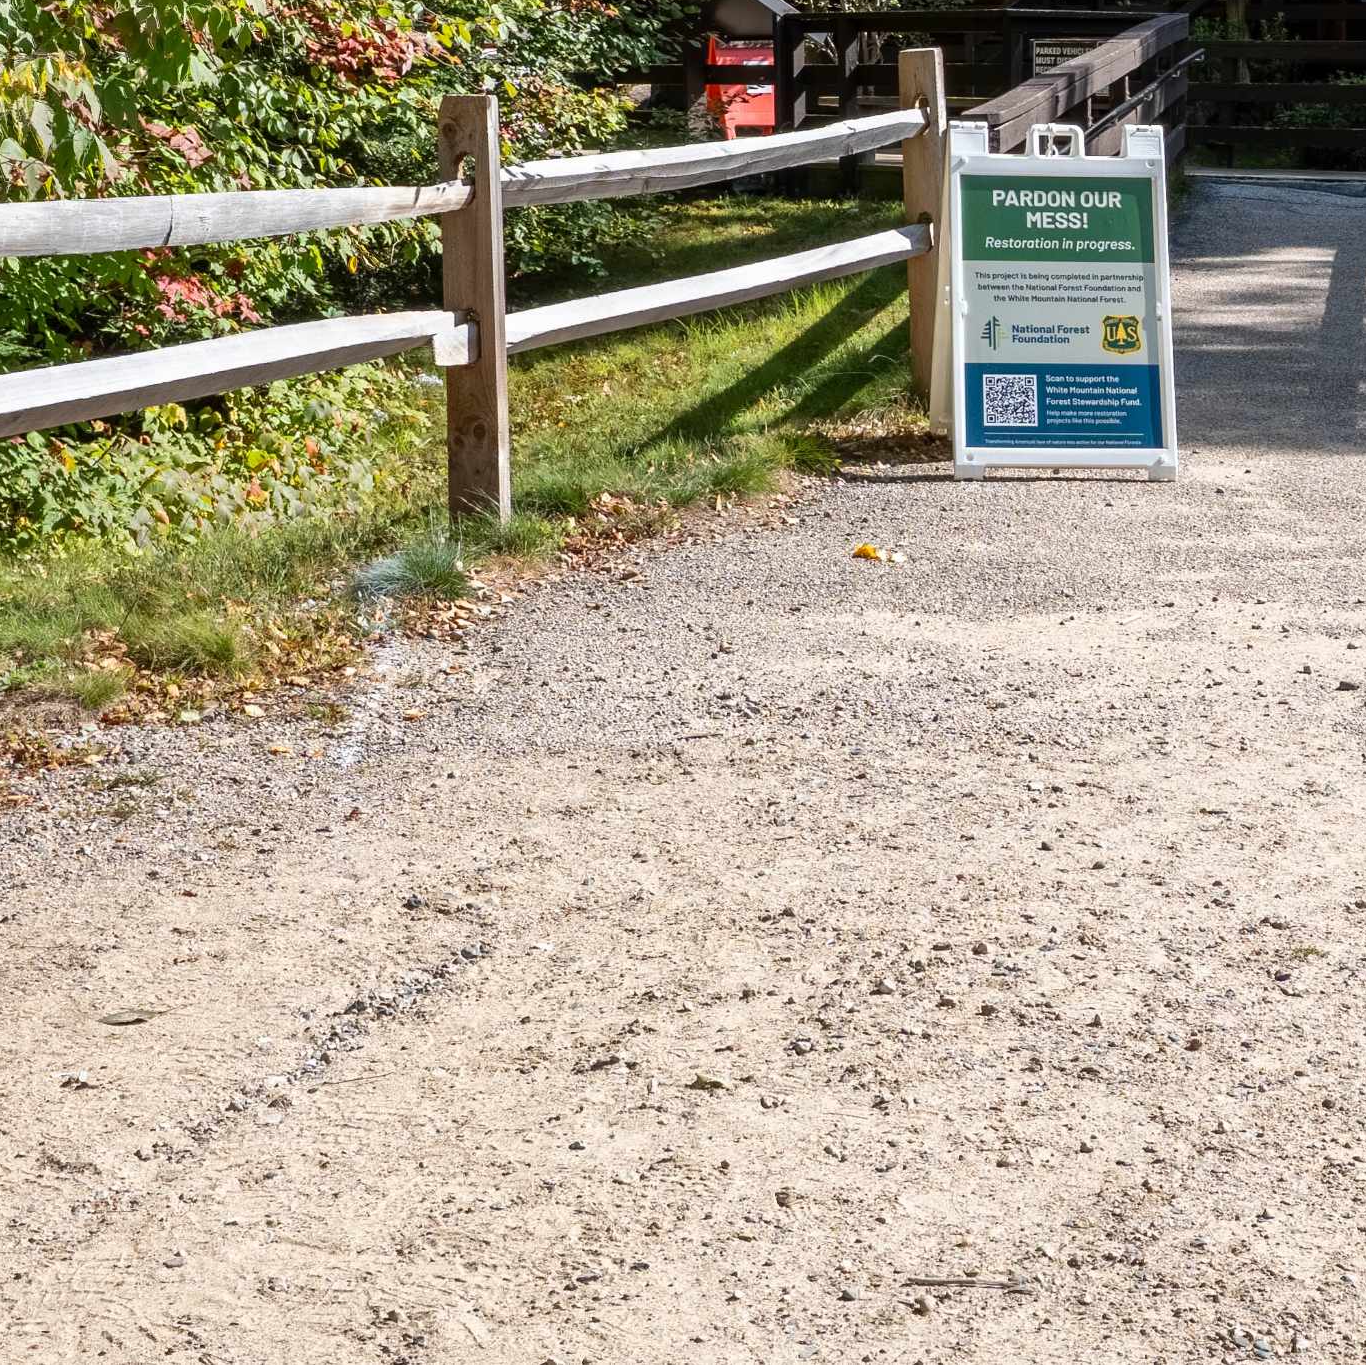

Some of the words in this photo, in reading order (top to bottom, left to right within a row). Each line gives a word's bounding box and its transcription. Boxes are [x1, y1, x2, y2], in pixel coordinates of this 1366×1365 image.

[1036, 47, 1061, 55] PARKED
[993, 190, 1075, 207] PARDON
[1080, 191, 1122, 208] OUR
[1027, 212, 1088, 229] MESS!
[985, 237, 1059, 249] Restoration
[1062, 238, 1071, 249] in
[1076, 240, 1135, 252] progress.
[992, 273, 1019, 282] project
[1028, 273, 1049, 281] being
[1051, 273, 1091, 282] completed
[1100, 274, 1144, 282] partnership
[1067, 295, 1098, 303] National
[1012, 324, 1055, 334] National
[1057, 325, 1090, 334] Forest
[1012, 335, 1070, 344] Foundation
[1075, 376, 1105, 384] support
[1072, 398, 1119, 406] Stewardship
[1121, 398, 1142, 406] Fund.
